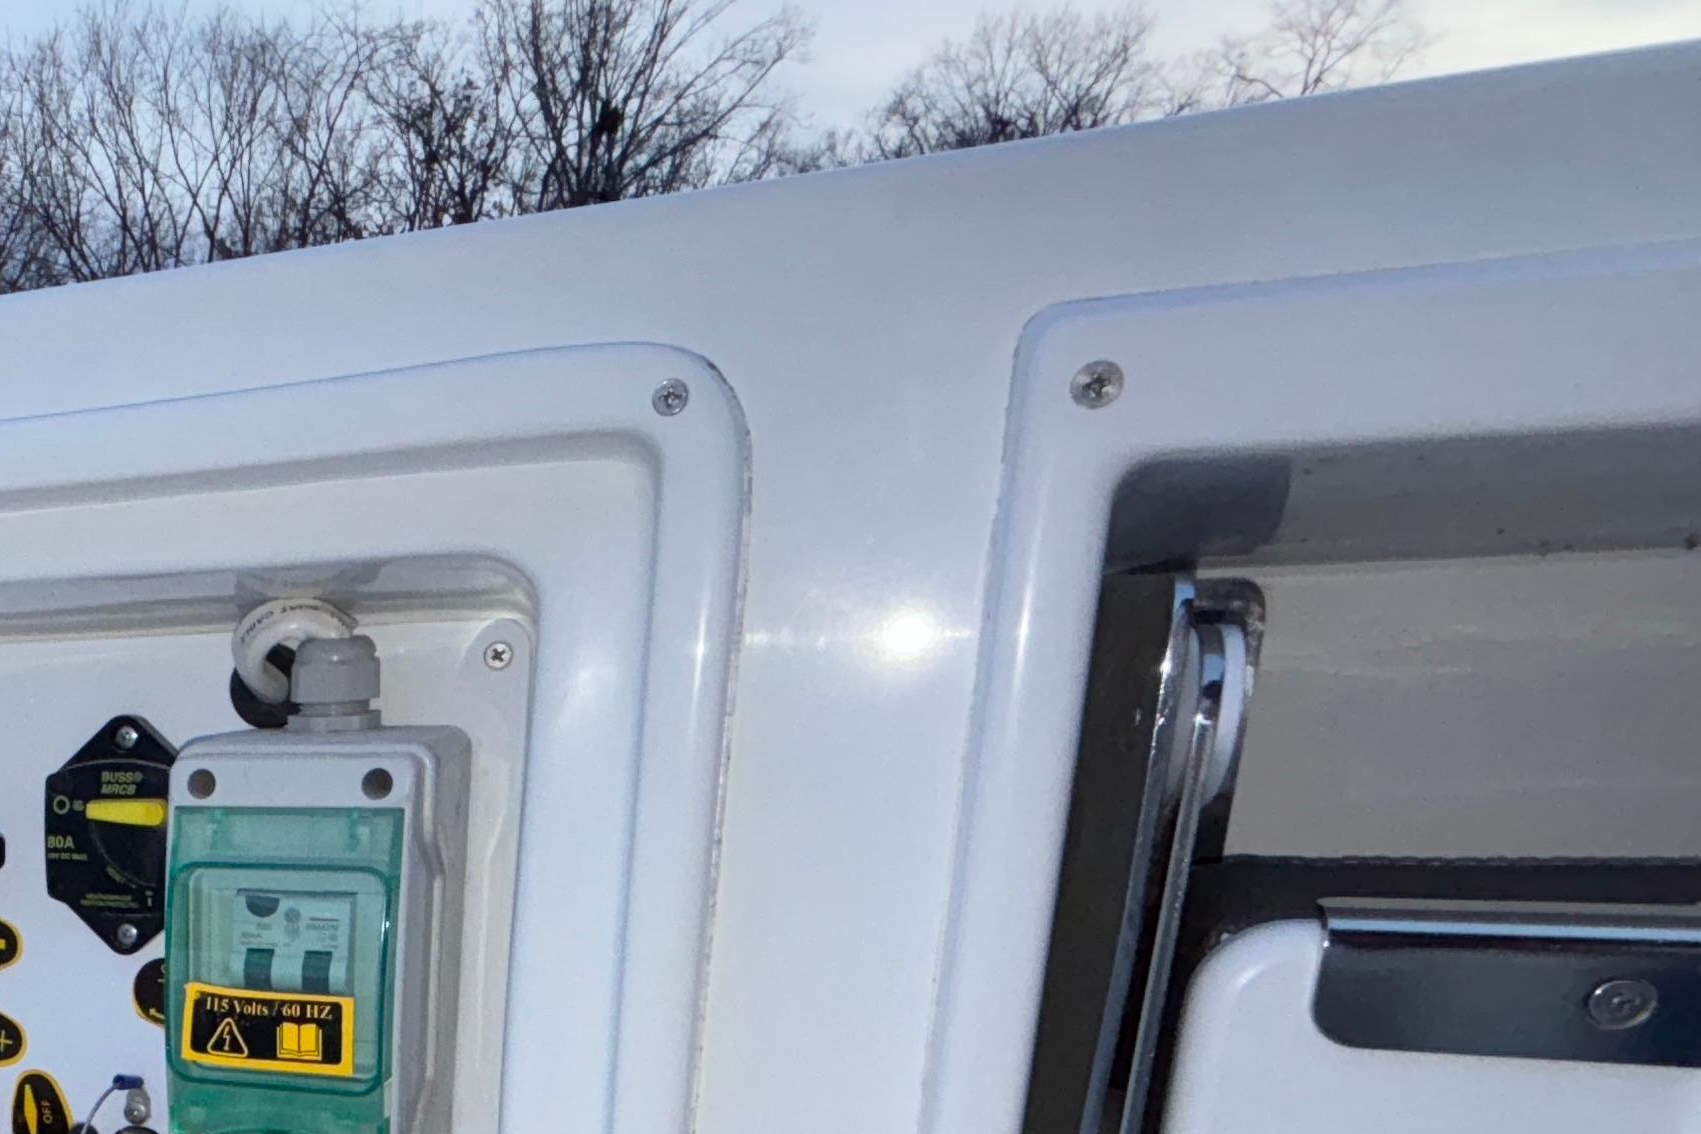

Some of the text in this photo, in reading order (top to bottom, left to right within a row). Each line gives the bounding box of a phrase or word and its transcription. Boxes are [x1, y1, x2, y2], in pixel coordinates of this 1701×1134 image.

[47, 836, 75, 849] 80A
[205, 996, 229, 1013] 115
[233, 1000, 269, 1016] Volts
[281, 1003, 300, 1017] 60
[305, 1004, 333, 1019] HZ
[41, 1100, 53, 1124] OFF
